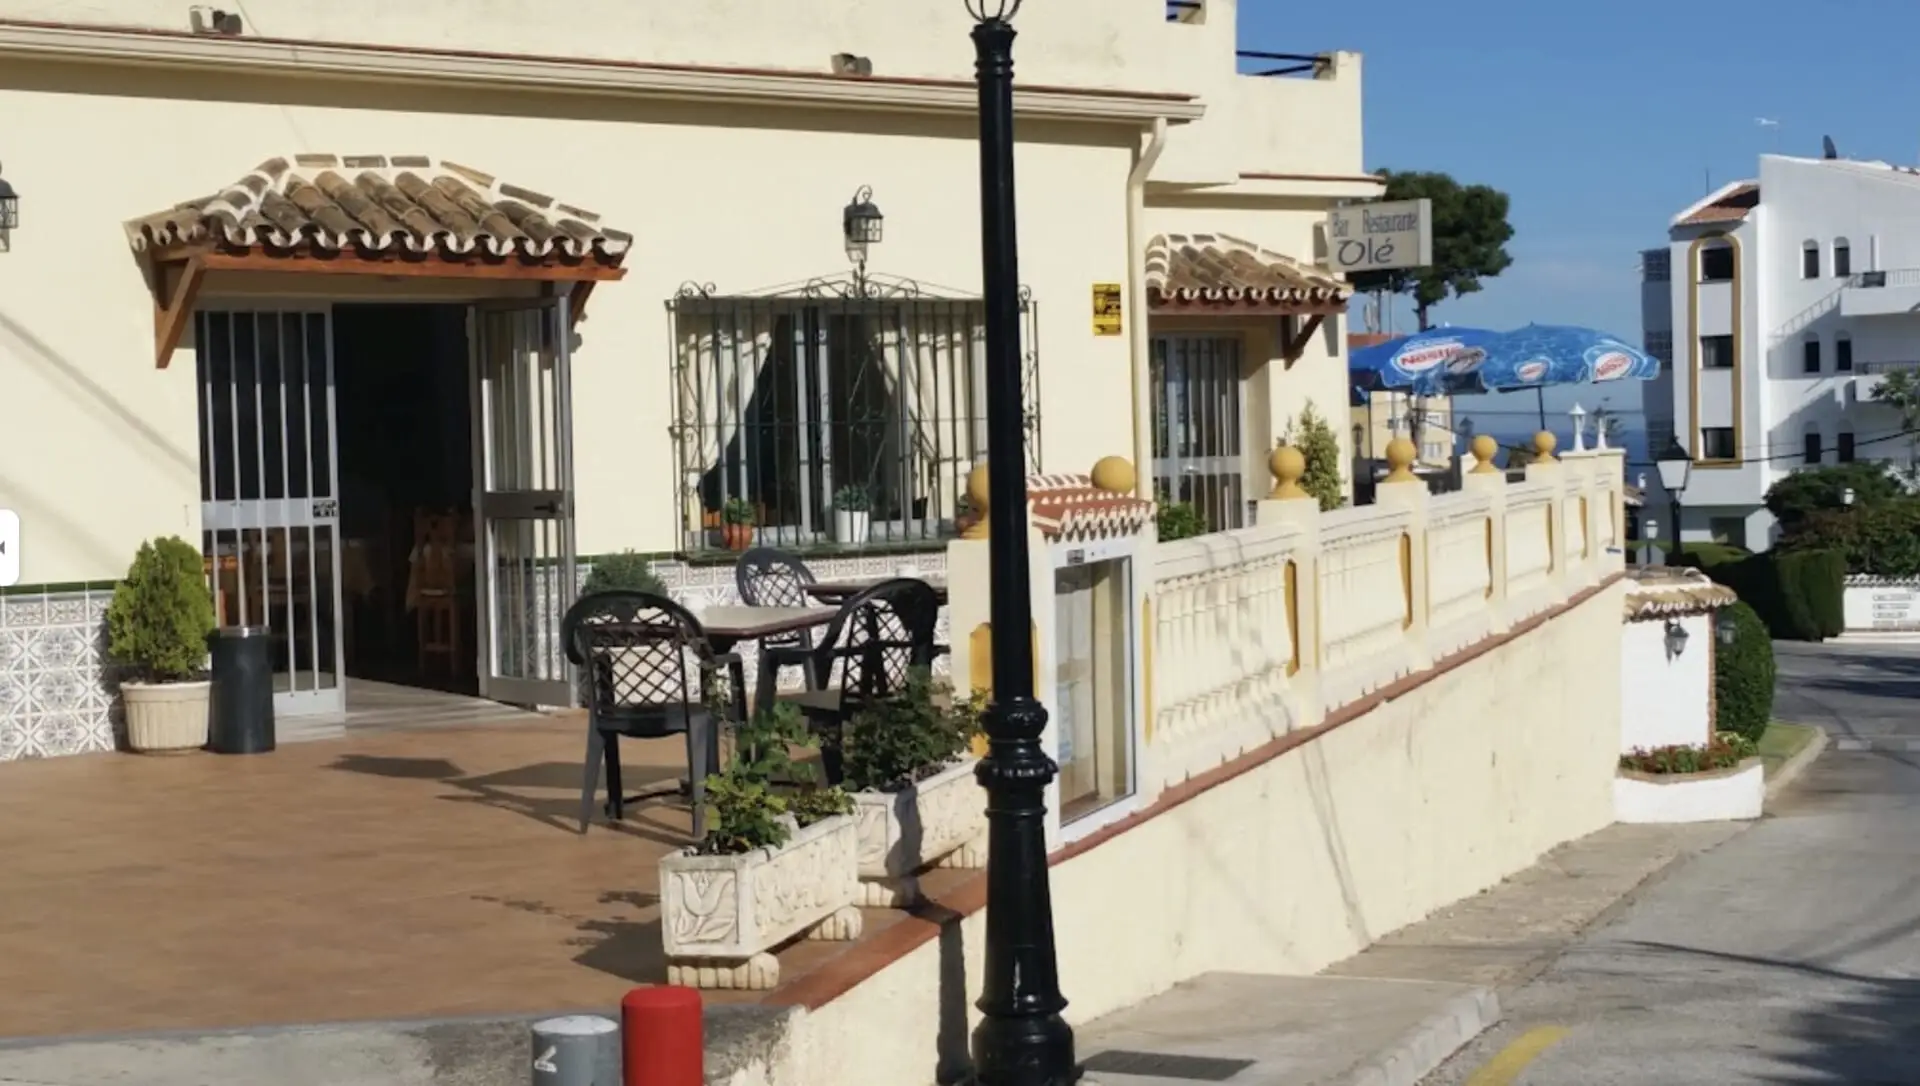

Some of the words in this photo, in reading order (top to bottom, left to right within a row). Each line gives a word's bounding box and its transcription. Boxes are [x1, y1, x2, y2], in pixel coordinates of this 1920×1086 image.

[1332, 212, 1349, 237] Bar
[1362, 209, 1417, 234] Restaurante
[1338, 237, 1395, 266] Olé
